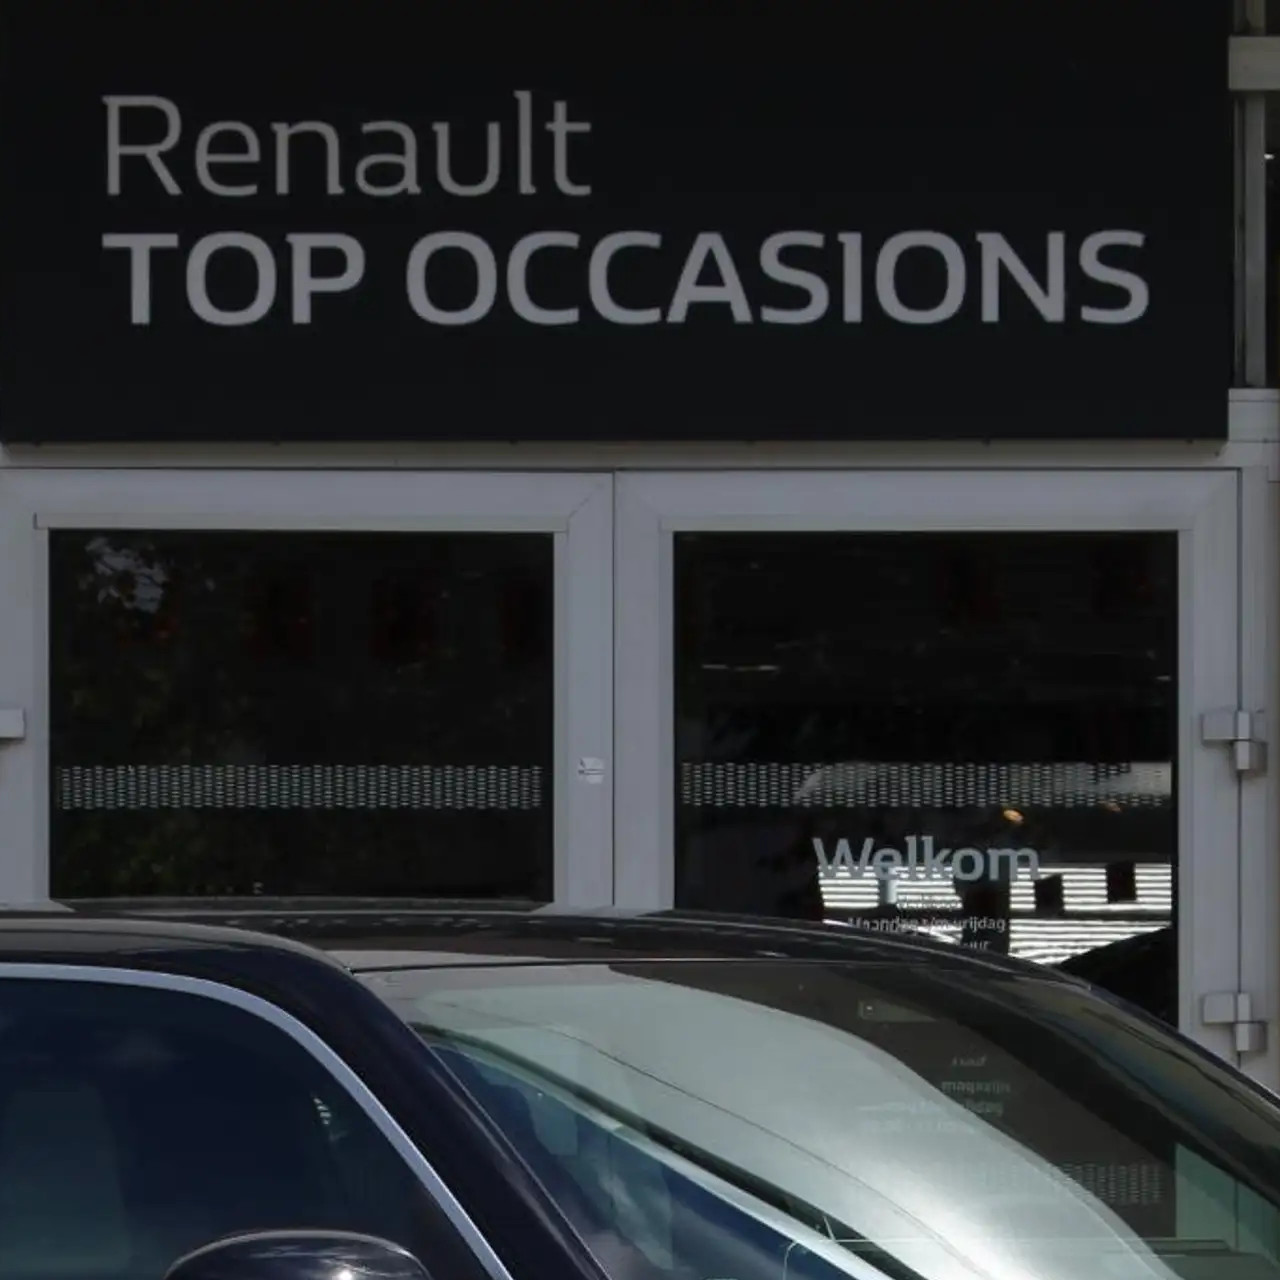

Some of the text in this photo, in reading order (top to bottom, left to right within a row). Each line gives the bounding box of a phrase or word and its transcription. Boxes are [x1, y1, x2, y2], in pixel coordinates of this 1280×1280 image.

[101, 90, 593, 197] Renault
[102, 230, 1150, 326] TOP OCCASIONS
[812, 835, 1042, 881] Welkom
[954, 915, 1007, 932] vrijdag
